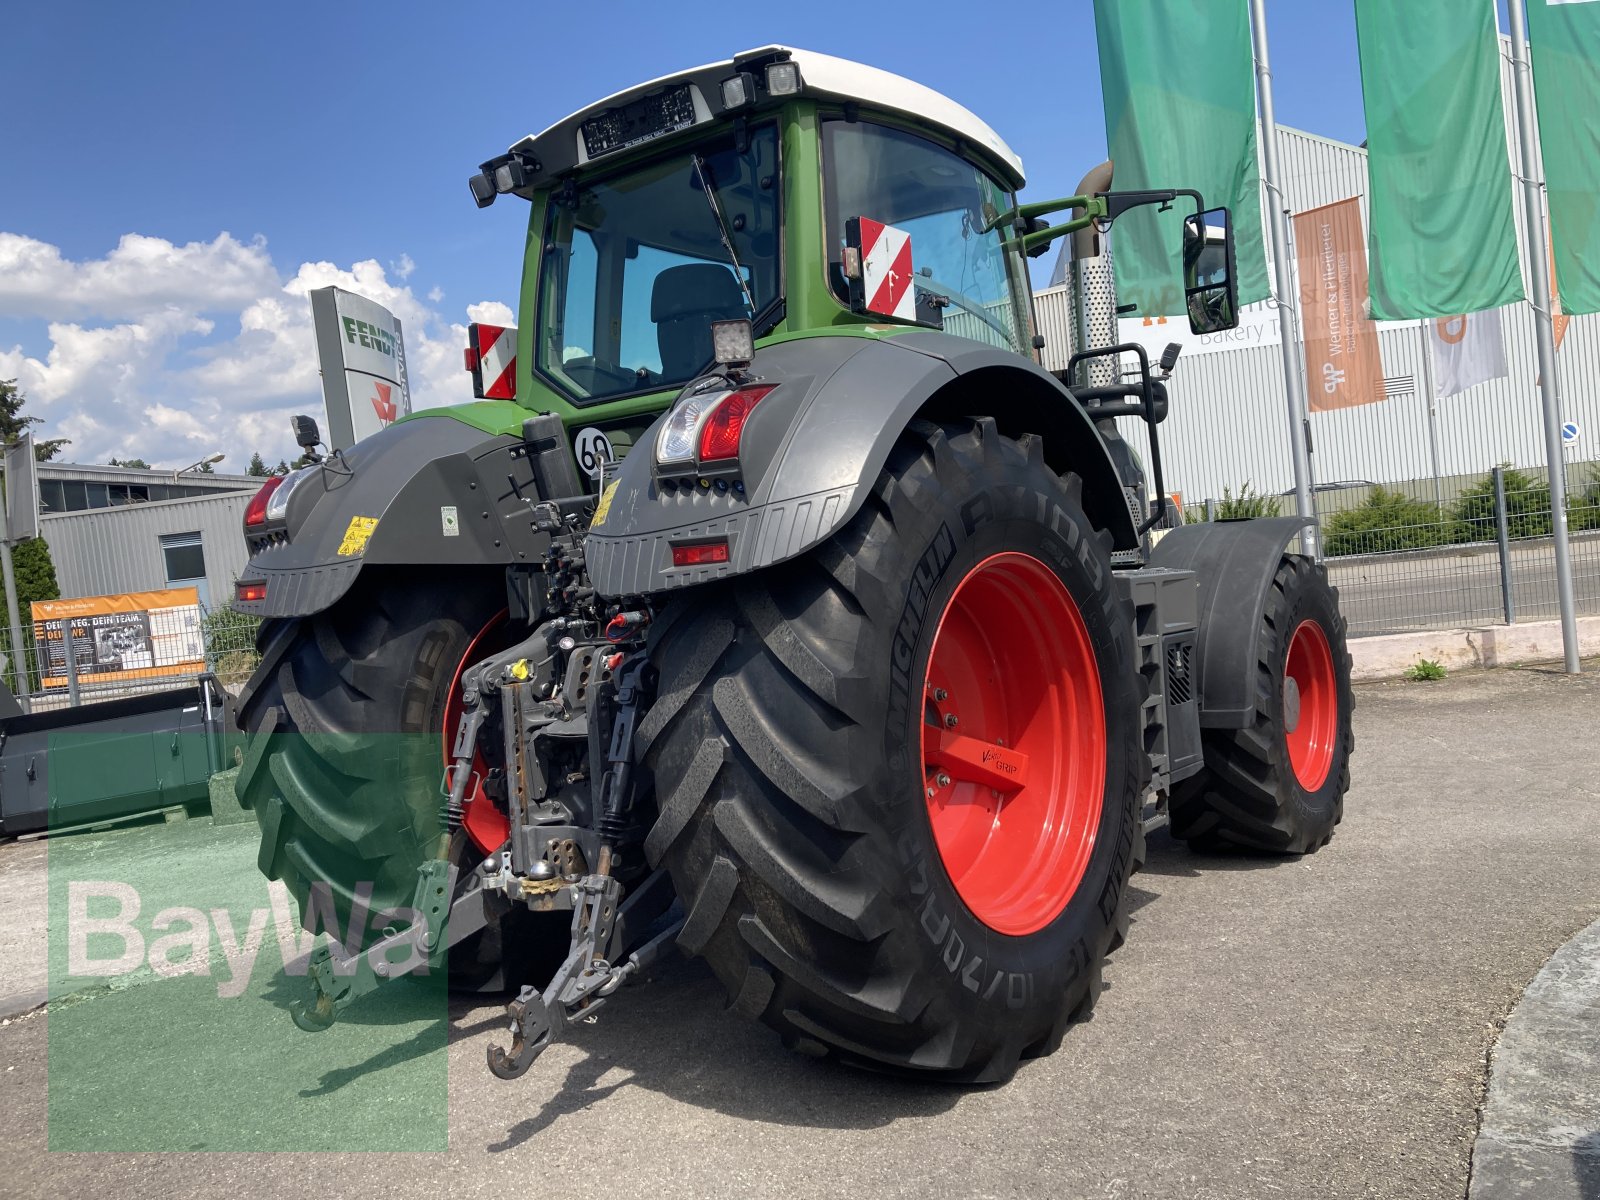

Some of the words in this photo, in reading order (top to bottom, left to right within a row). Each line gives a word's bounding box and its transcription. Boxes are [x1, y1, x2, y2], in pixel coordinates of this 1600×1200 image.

[1319, 223, 1337, 290] Pfleiderer
[1327, 291, 1339, 307] &
[1337, 252, 1354, 319] Technologies
[341, 315, 397, 359] FENDT
[1328, 306, 1343, 357] Werner
[1343, 320, 1356, 354] Bakery
[92, 616, 113, 626] DEIN
[115, 613, 142, 624] TEAM.
[996, 760, 1018, 775] GRIP
